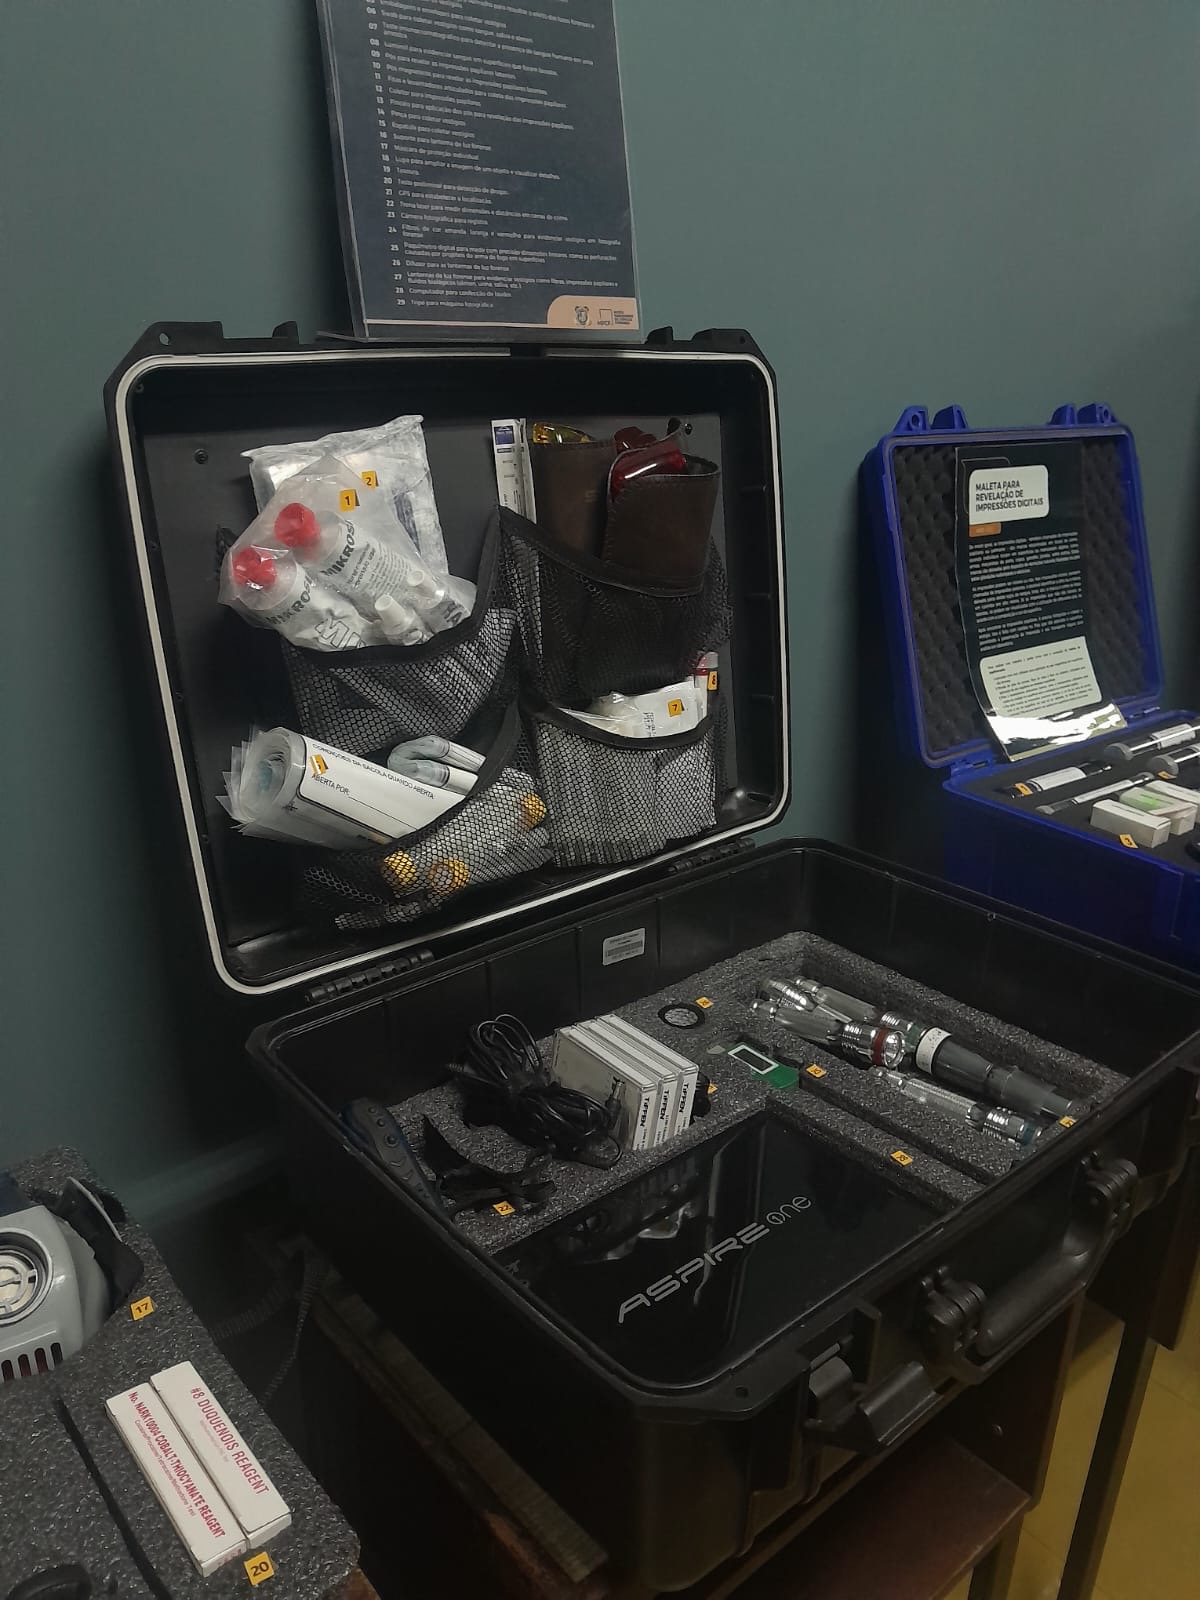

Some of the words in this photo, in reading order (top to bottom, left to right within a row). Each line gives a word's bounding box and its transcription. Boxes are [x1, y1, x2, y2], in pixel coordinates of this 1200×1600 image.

[377, 107, 384, 115] 14
[365, 476, 373, 486] 2
[976, 481, 1001, 491] MALETA
[1003, 479, 1020, 489] PARA
[344, 495, 351, 506] 1
[976, 488, 1014, 502] REVELAÇÃO
[1015, 490, 1023, 498] DE
[976, 499, 1016, 512] IMPRESSÕES
[1017, 498, 1043, 508] DIGITAIS
[618, 1222, 770, 1323] ASPIRE
[766, 1195, 812, 1225] one
[136, 1303, 150, 1314] 17
[190, 1386, 202, 1399] #8
[197, 1399, 236, 1451] DUQUENOIS
[231, 1449, 269, 1495] REAGENT
[128, 1391, 139, 1404] No.
[154, 1434, 205, 1507] COBALT-THIOCYANATE
[200, 1499, 226, 1538] REAGENT
[250, 1561, 269, 1577] 20
